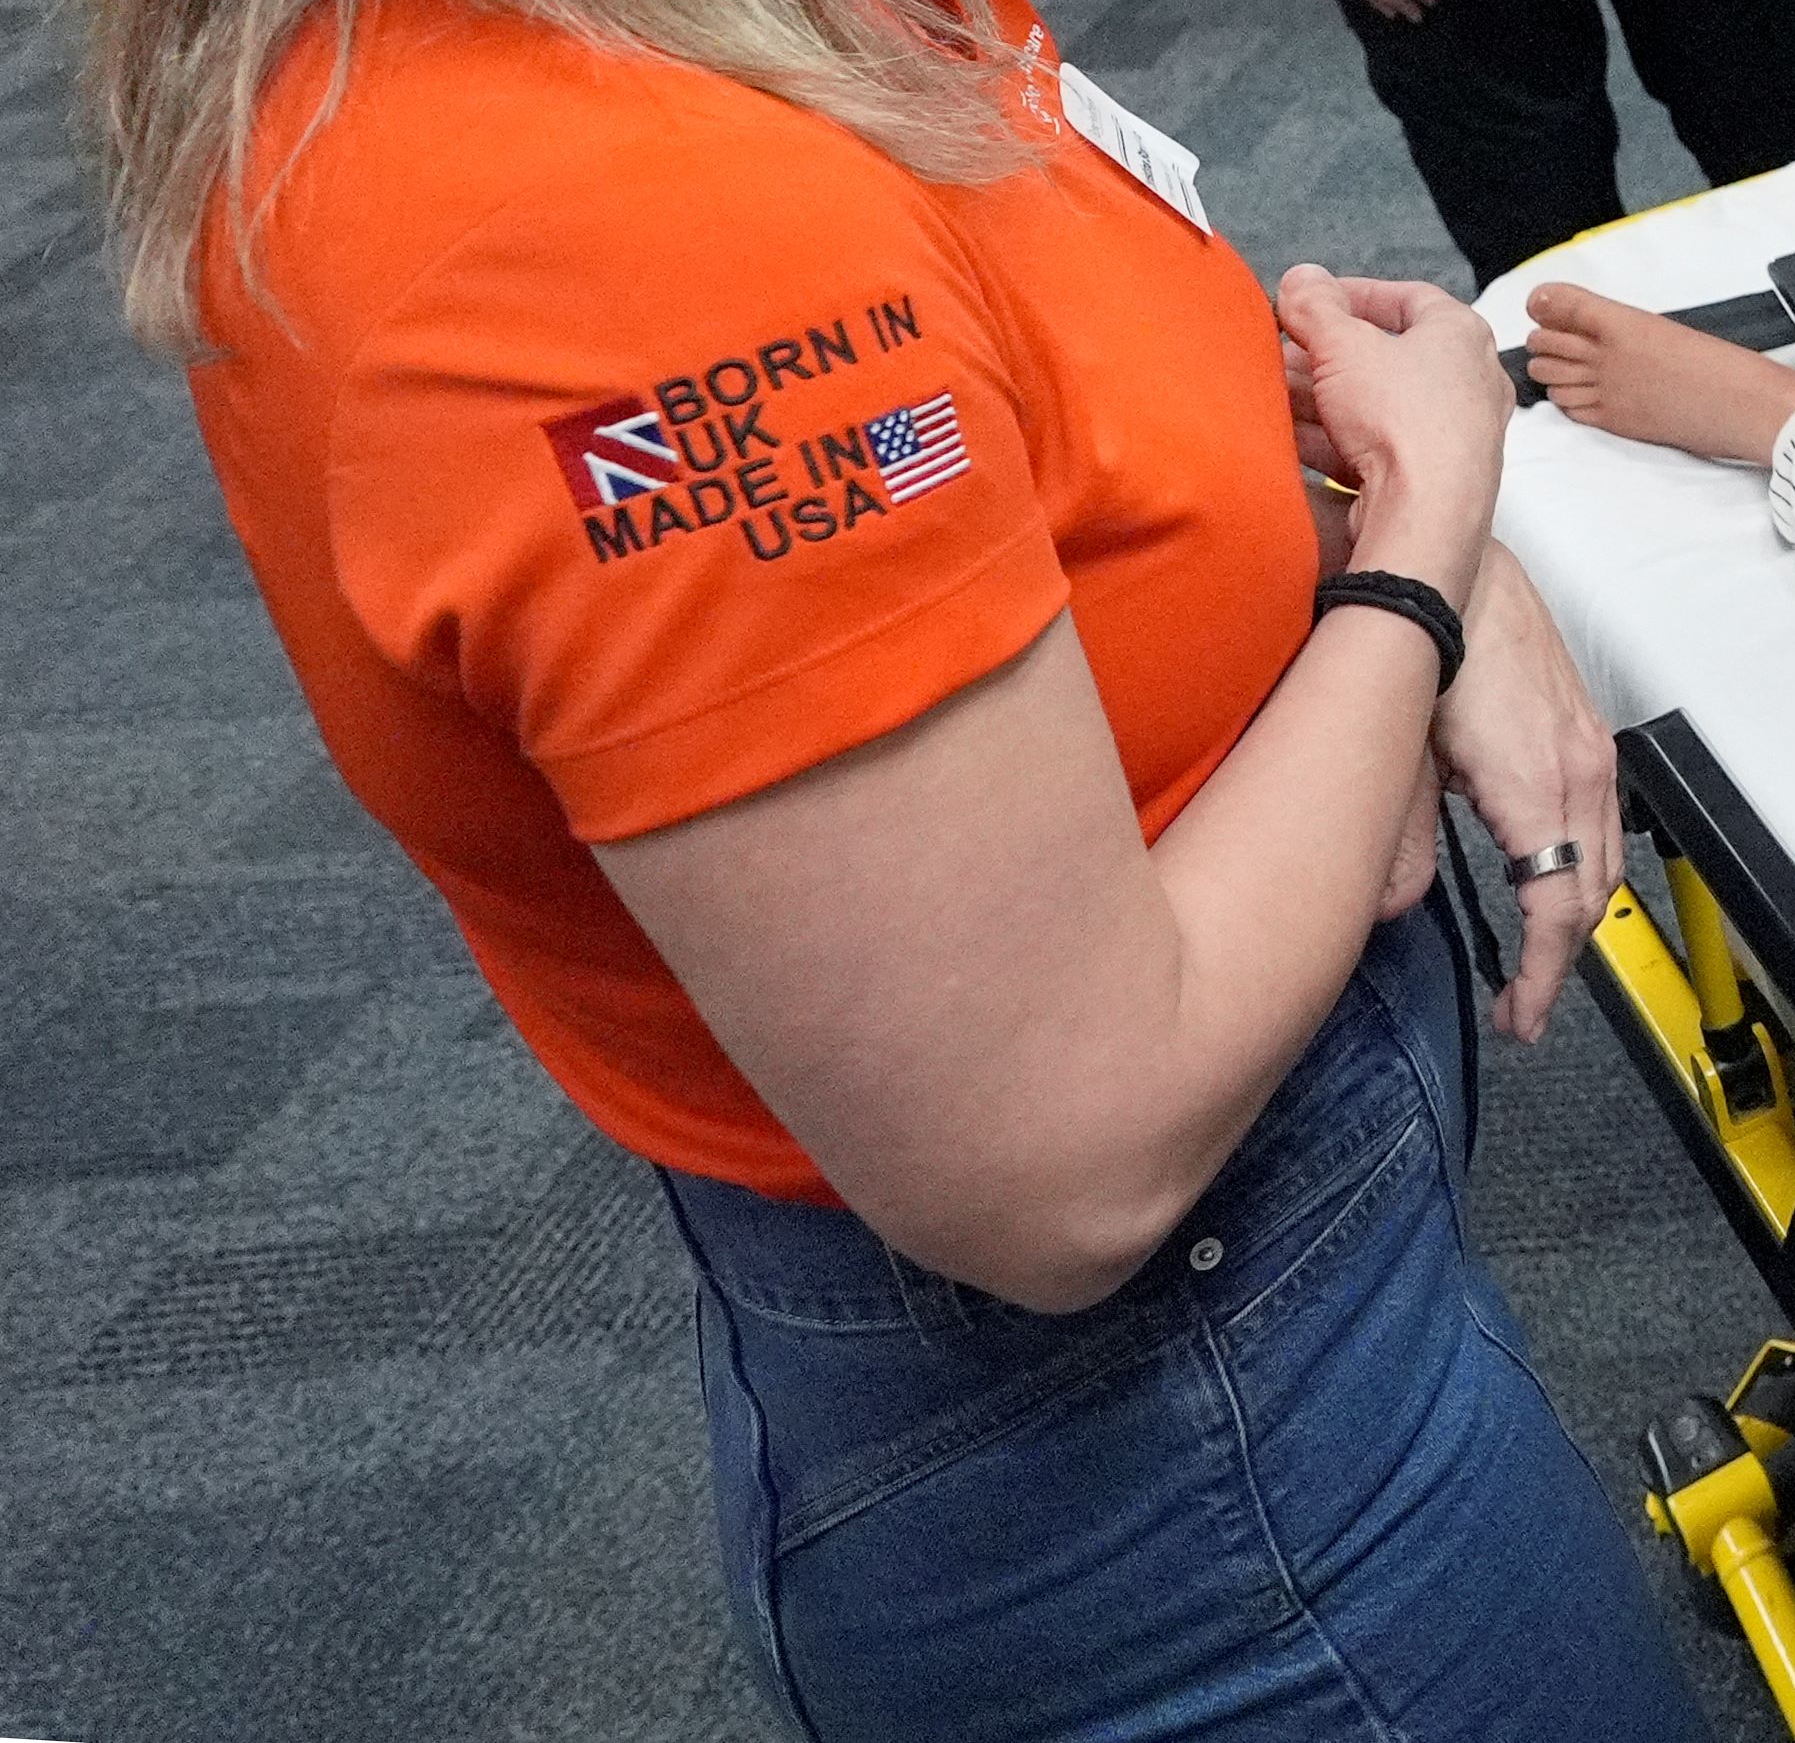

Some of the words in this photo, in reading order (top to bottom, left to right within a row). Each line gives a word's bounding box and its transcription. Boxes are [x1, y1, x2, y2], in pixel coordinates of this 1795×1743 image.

[655, 320, 857, 425] BORN
[867, 295, 922, 352] IN
[676, 403, 781, 473] UK
[583, 457, 787, 563] MADE
[799, 426, 869, 488] IN
[741, 480, 887, 561] USA
